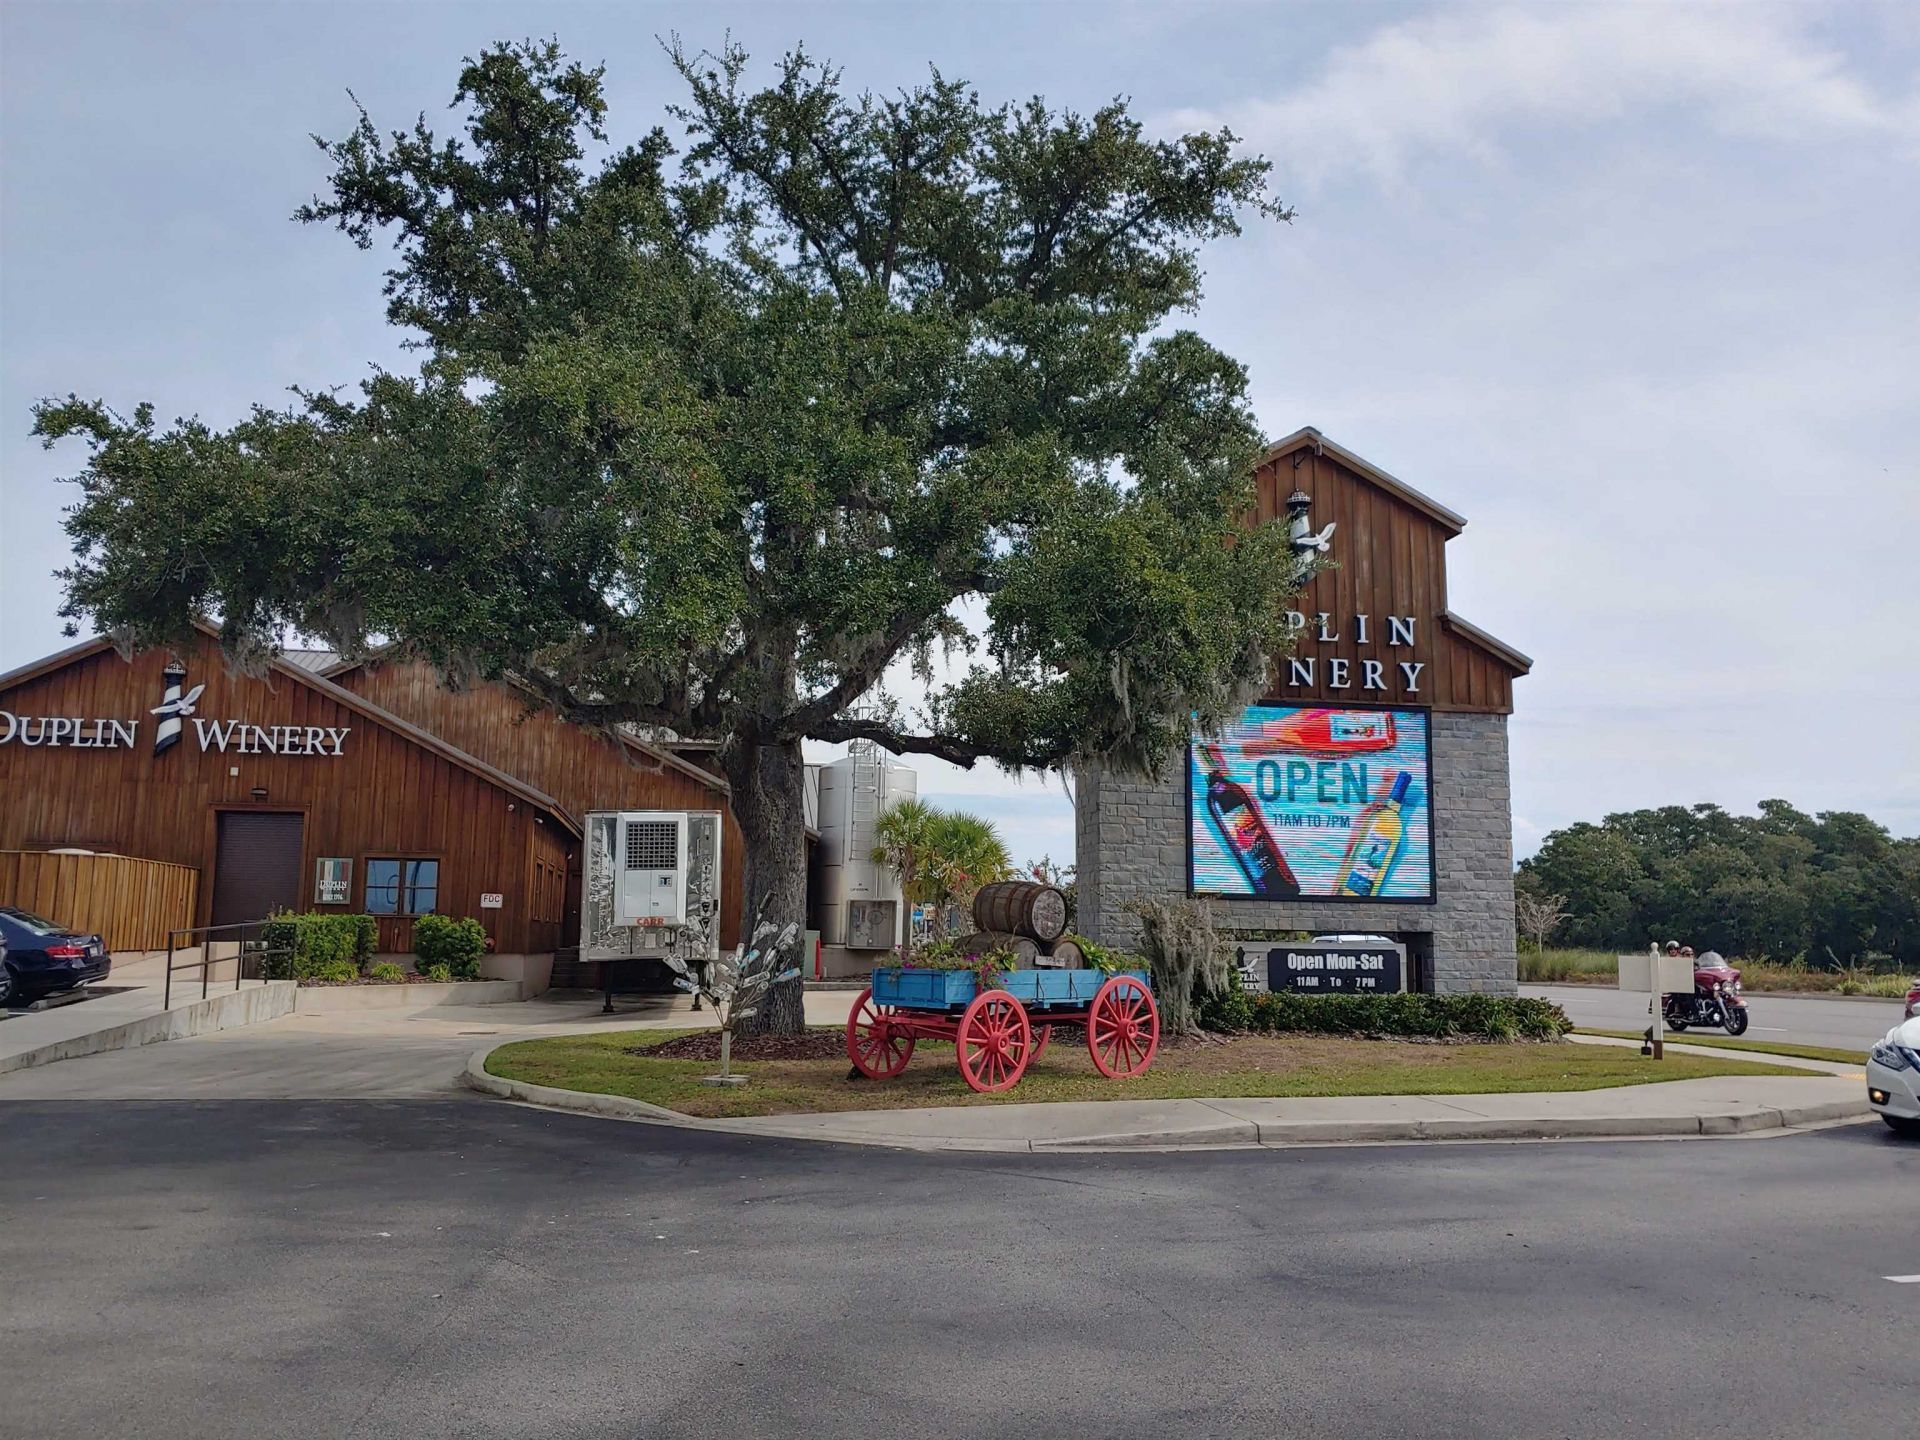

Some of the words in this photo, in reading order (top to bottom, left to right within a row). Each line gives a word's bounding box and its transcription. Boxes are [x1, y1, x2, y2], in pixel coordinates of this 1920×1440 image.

[1286, 656, 1425, 692] NERY
[192, 718, 351, 756] WINERY
[1256, 759, 1368, 804] OPEN
[1287, 952, 1324, 971] Open
[1326, 953, 1384, 970] Mon-Sat
[1330, 976, 1342, 987] To
